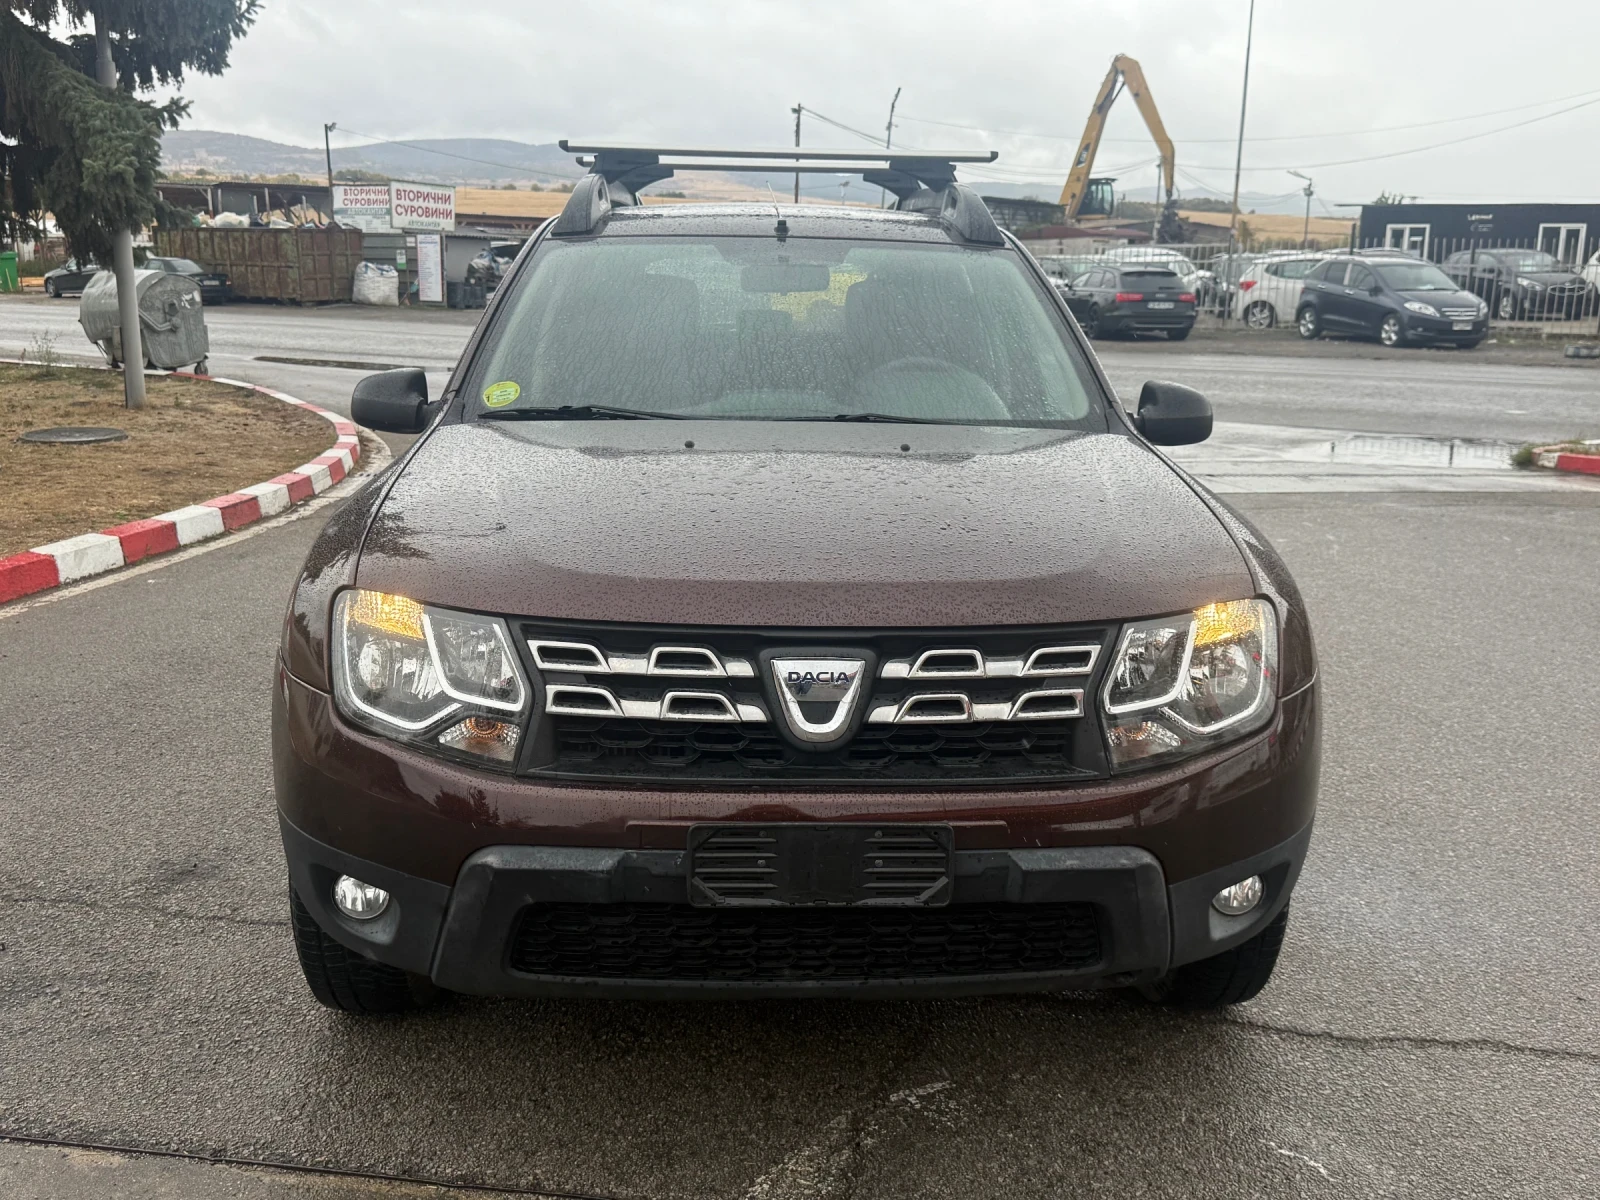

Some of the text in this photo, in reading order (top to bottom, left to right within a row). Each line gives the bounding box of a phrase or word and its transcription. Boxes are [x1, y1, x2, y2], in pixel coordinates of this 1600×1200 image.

[343, 188, 389, 196] ВТОРИЧНИ
[396, 189, 451, 205] ВТОРИЧНИ
[343, 198, 389, 206] СУРОВИНИ
[395, 204, 453, 220] СУРОВИНИ
[788, 671, 850, 683] DACIA
